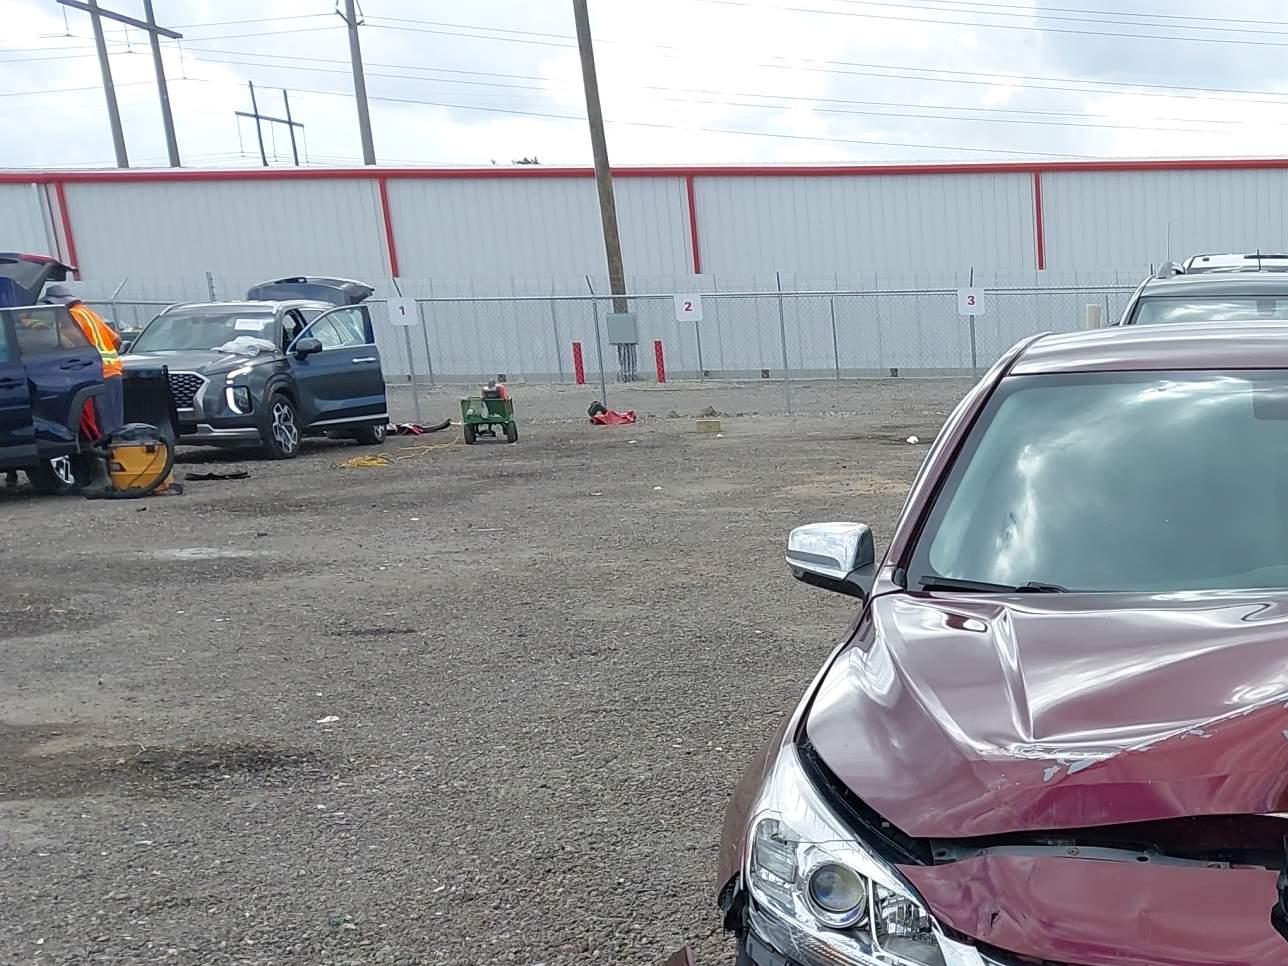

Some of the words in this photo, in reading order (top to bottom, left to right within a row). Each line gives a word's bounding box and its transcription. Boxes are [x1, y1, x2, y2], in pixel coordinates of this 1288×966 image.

[967, 295, 976, 306] 3
[398, 305, 406, 316] 1
[684, 301, 693, 312] 2
